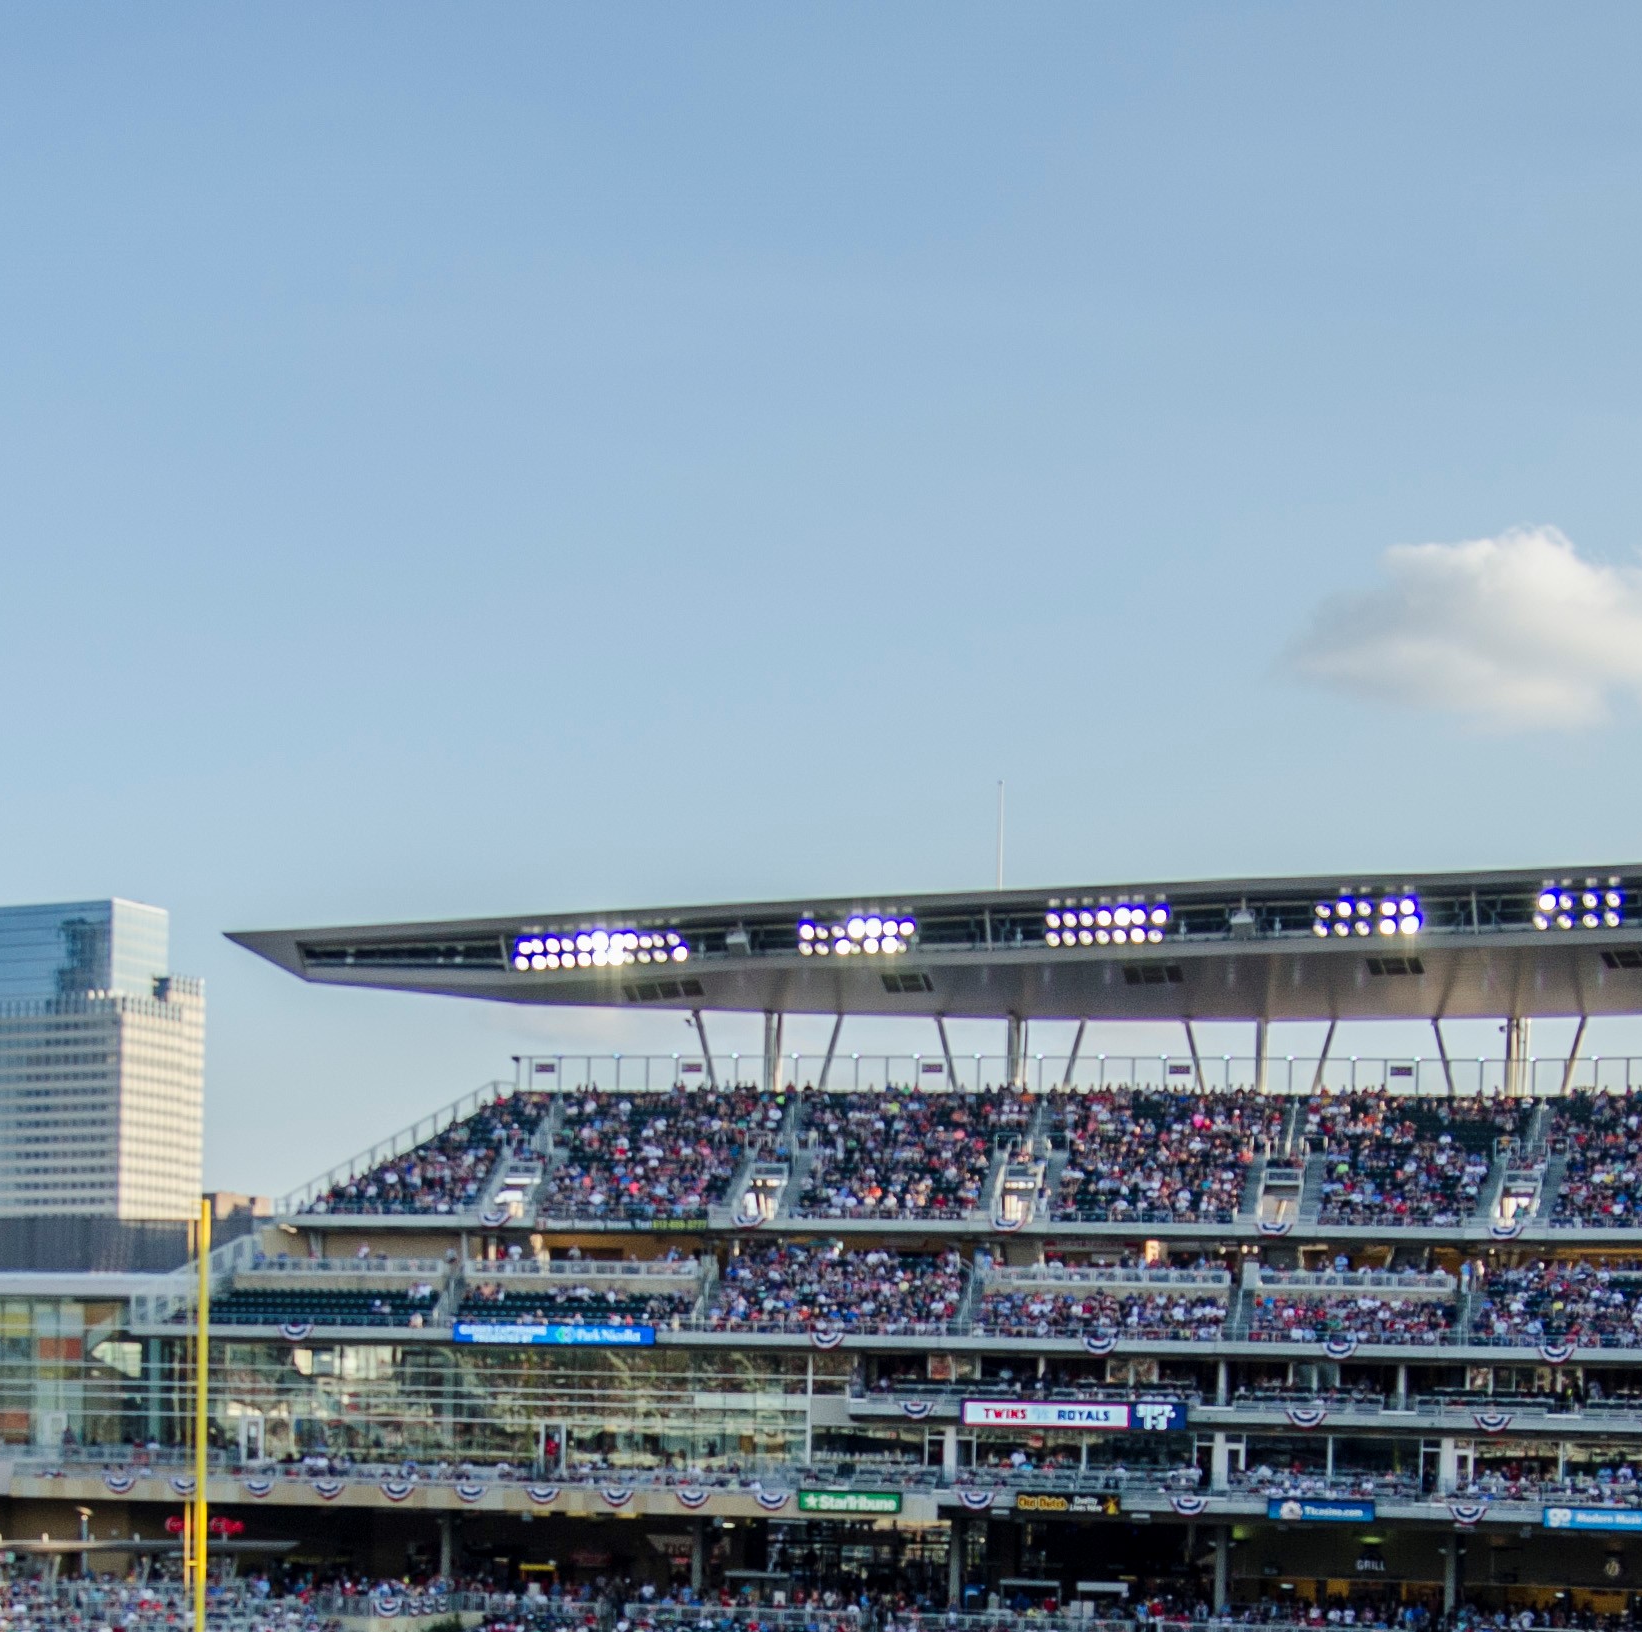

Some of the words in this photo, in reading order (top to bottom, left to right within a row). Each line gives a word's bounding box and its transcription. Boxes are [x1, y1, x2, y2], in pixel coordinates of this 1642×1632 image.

[576, 1328, 600, 1342] Park
[983, 1407, 1029, 1421] TWINS
[1057, 1408, 1111, 1423] ROYALS
[818, 1493, 898, 1512] StarTribune
[1356, 1558, 1387, 1572] GRILL
